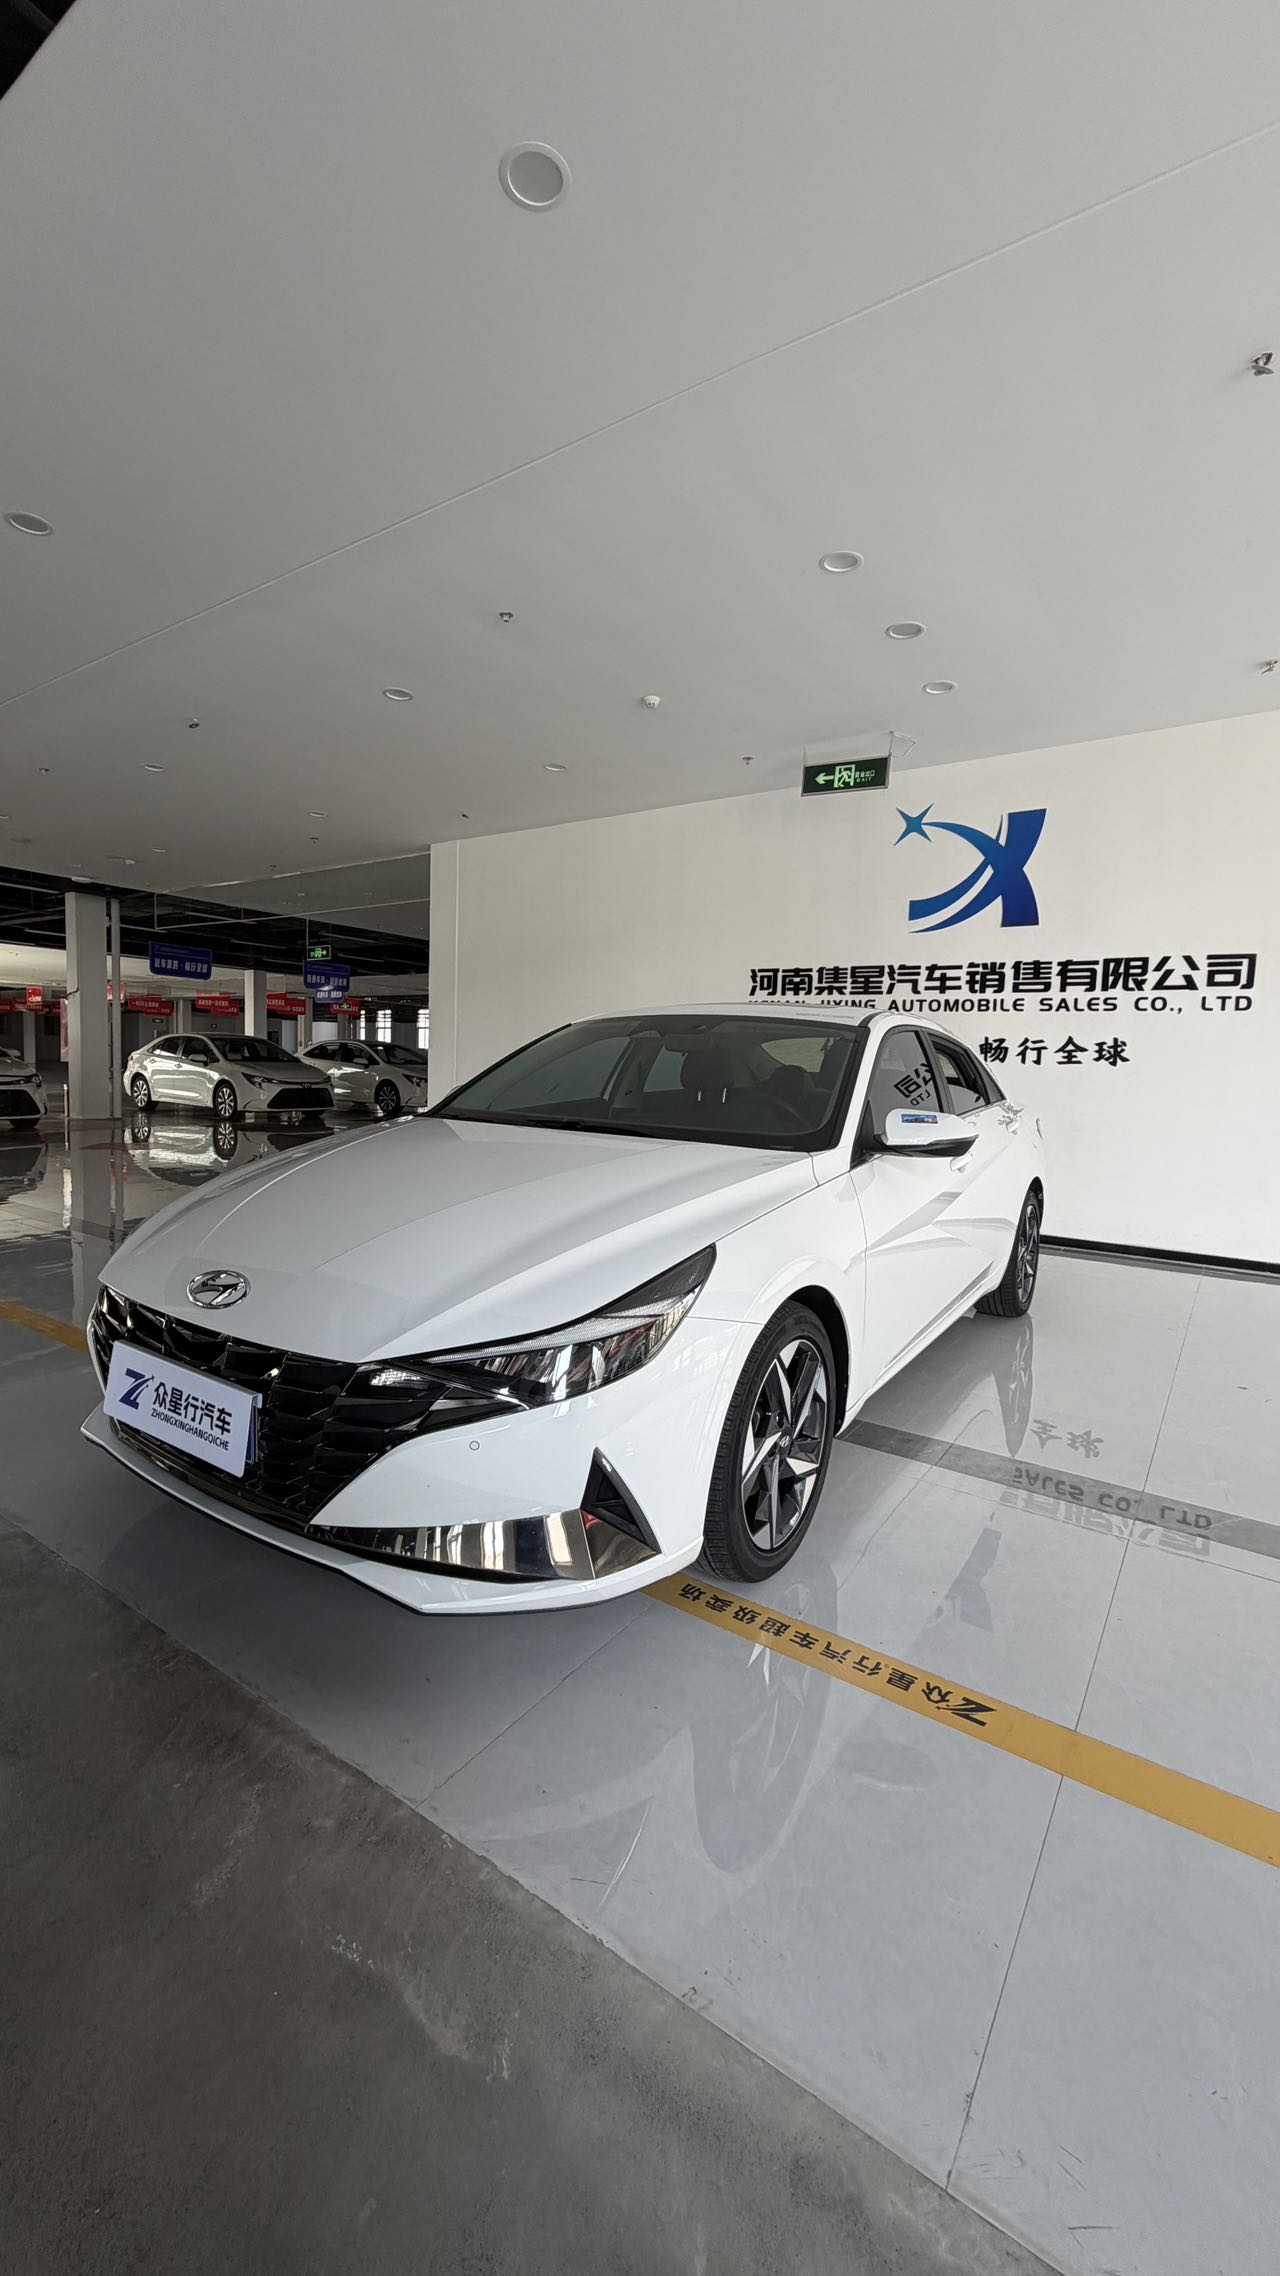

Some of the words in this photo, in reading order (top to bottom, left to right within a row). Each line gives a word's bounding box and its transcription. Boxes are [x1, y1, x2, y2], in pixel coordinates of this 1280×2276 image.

[750, 953, 1257, 996] 河南集星汽车销售有限公司
[888, 998, 1025, 1012] AUTOMOBILE
[1039, 997, 1118, 1012] SALES
[1133, 997, 1183, 1014] CO.,
[1200, 996, 1253, 1011] LTD
[979, 1035, 1131, 1067] 畅行全球
[151, 1408, 229, 1451] ZHONGXINGHANGQICHE
[152, 1381, 232, 1436] 众星行汽车
[679, 1584, 954, 1704] 众星行汽车超级卖场
